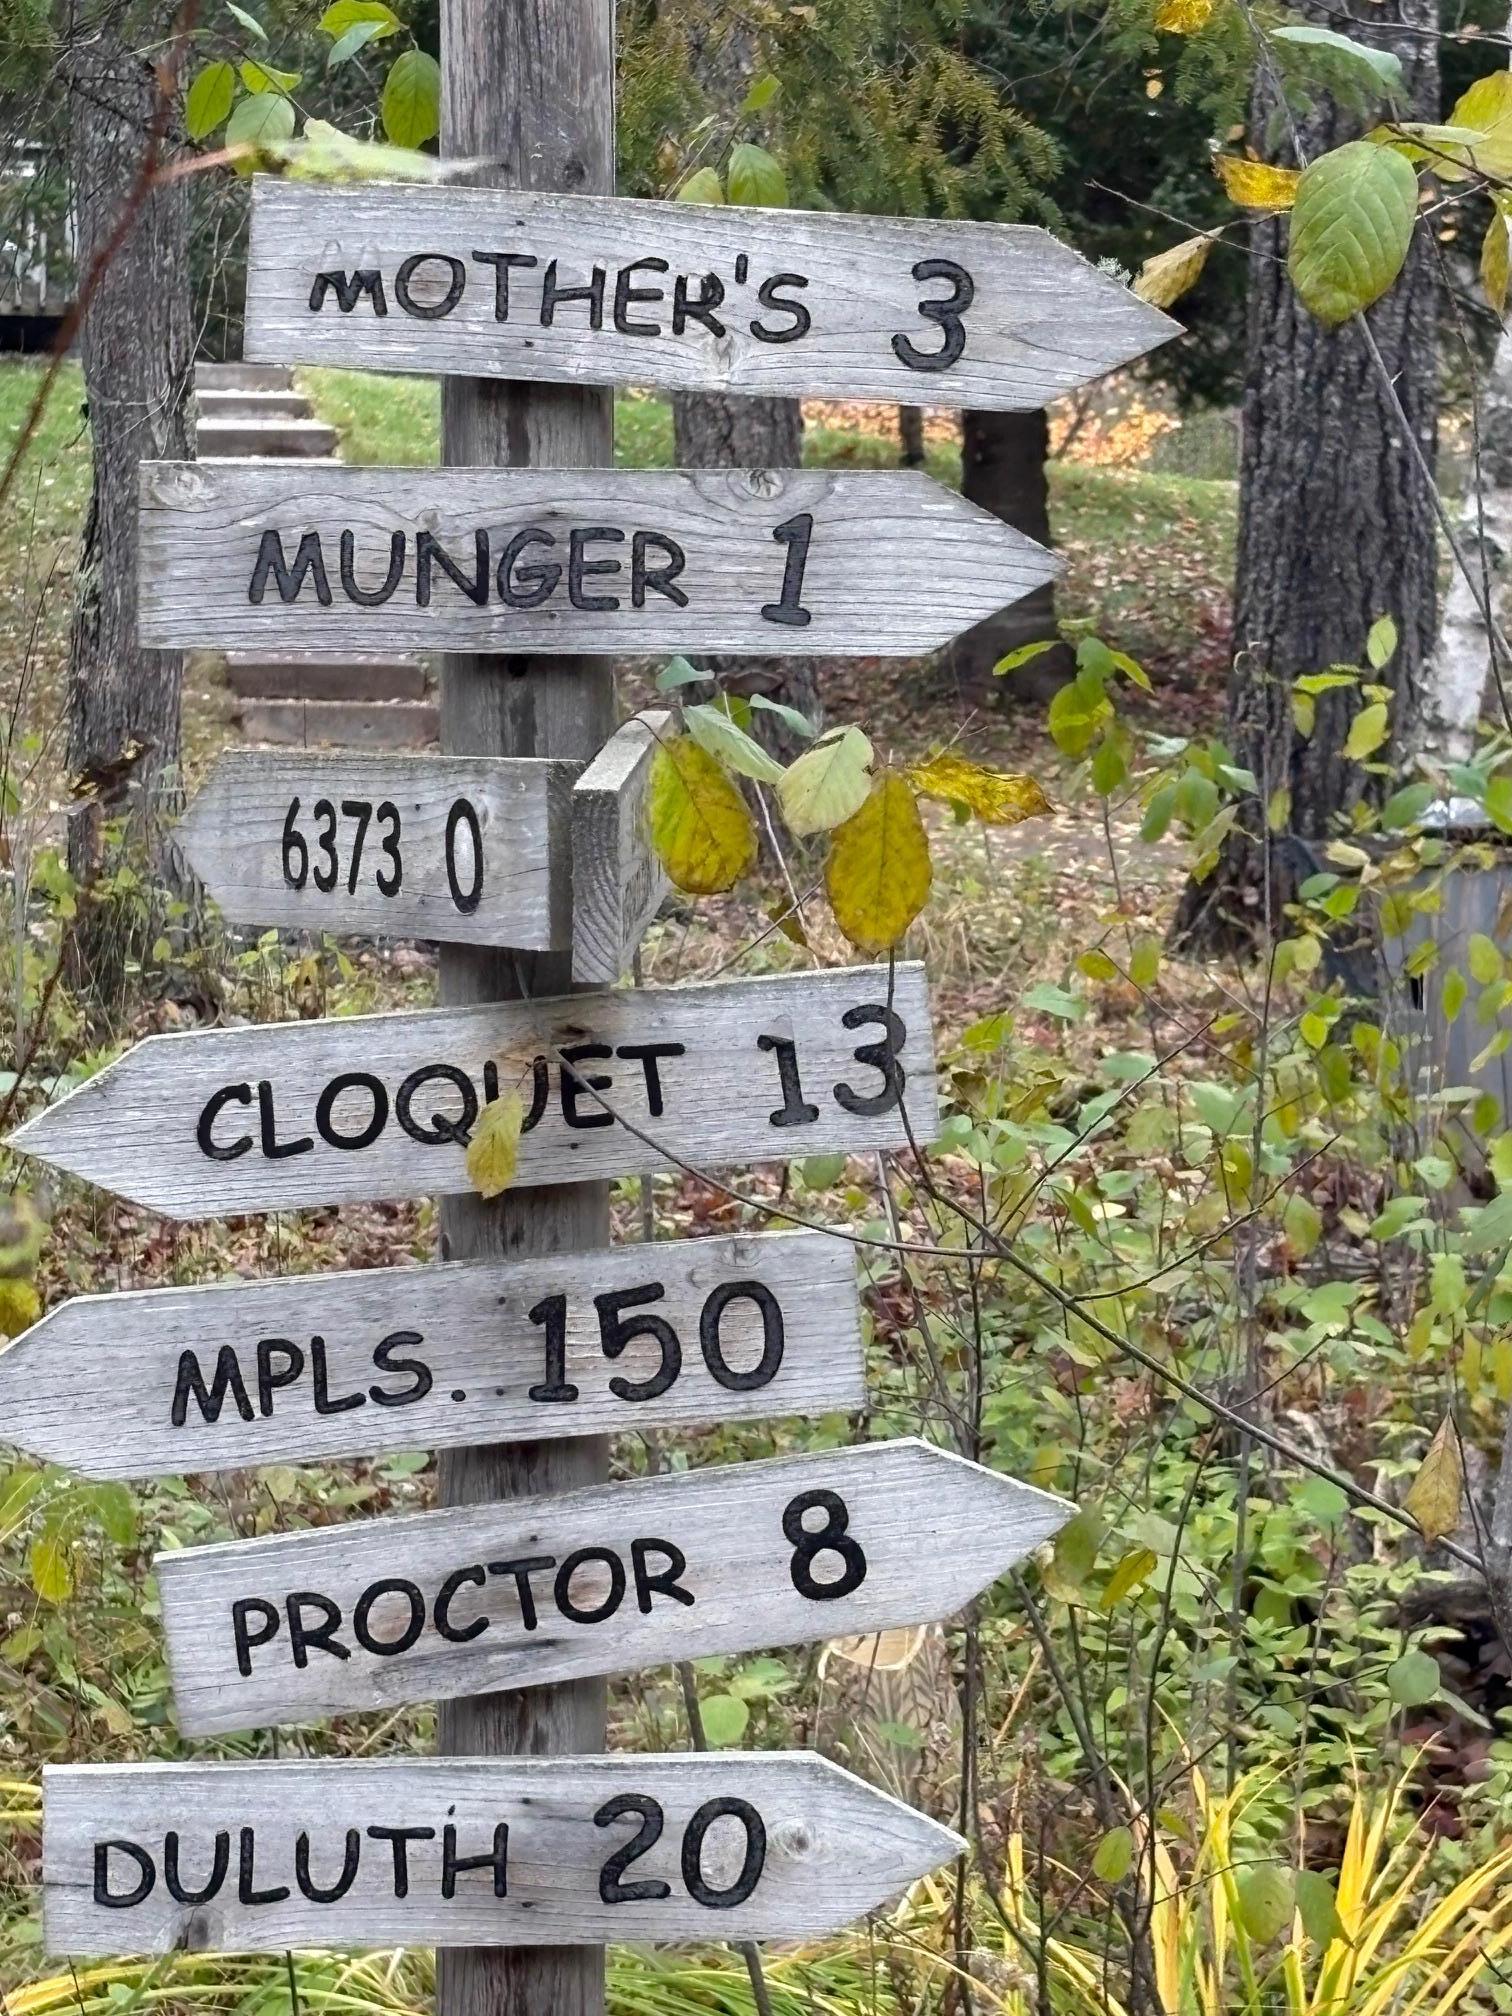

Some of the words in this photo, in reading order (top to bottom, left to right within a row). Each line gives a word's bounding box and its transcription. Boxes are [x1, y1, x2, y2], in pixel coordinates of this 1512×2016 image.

[308, 247, 812, 344] MOTHER'S
[891, 258, 975, 372] 3
[247, 526, 690, 612] MUNGER
[759, 512, 815, 628] 1
[281, 795, 404, 899] 6373
[444, 797, 485, 915] 0
[195, 1042, 688, 1161] CLOQUET
[756, 1003, 909, 1129] 13
[170, 1329, 468, 1428] MPLS.
[527, 1280, 786, 1404] 150
[231, 1537, 696, 1678] PROCTOR
[780, 1488, 868, 1603] 8
[92, 1821, 510, 1909] DULUTH
[592, 1791, 768, 1910] 20
